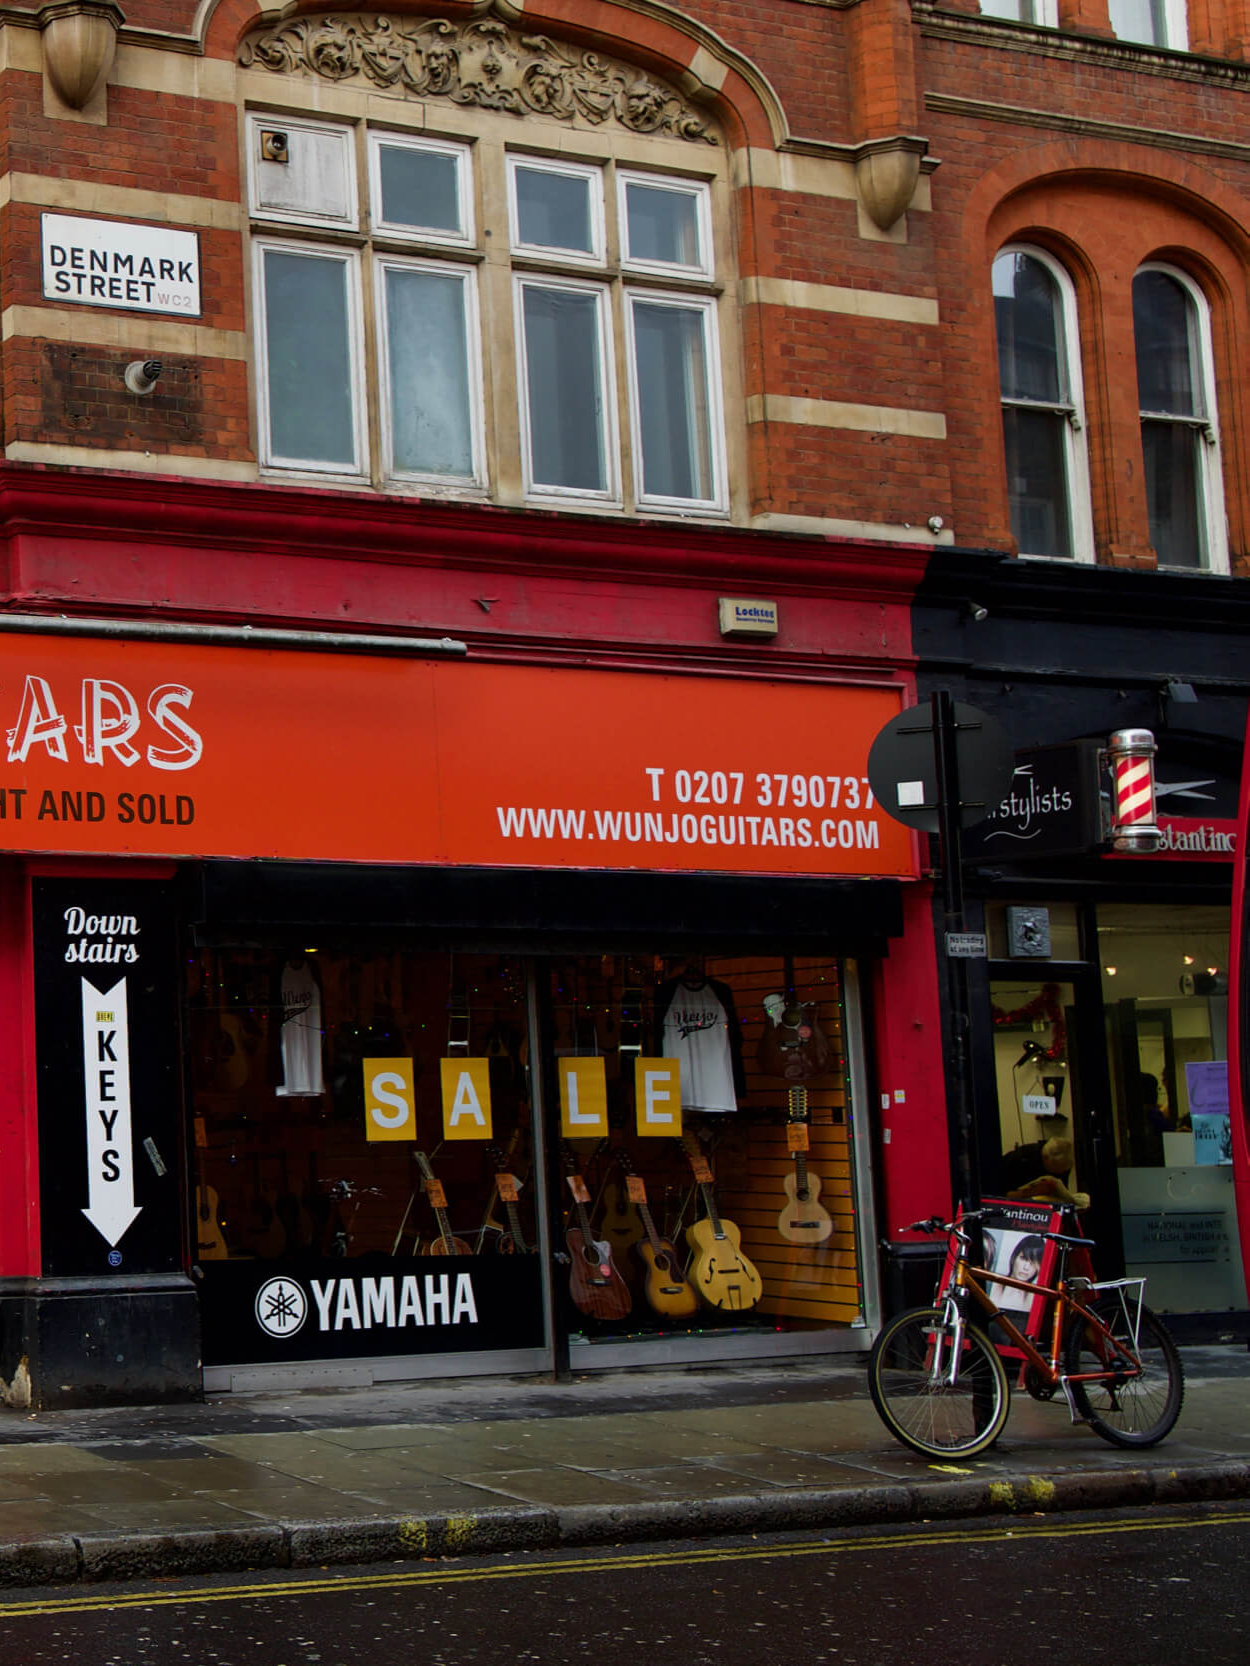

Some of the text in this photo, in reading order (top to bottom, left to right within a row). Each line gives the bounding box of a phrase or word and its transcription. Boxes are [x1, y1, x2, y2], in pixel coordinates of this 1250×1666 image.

[49, 244, 194, 284] DENMARK
[54, 270, 192, 309] STREET WC2
[37, 789, 106, 823] AND
[117, 792, 196, 826] SOLD
[645, 766, 876, 810] T 0207 3790737
[496, 806, 881, 850] WWW.WUNJOGUITARS.COM
[63, 906, 141, 936] Down
[64, 936, 140, 963] stairs
[97, 1030, 122, 1183] KEYS
[370, 1070, 673, 1129] SALE
[1029, 1100, 1050, 1111] OPEN
[310, 1273, 479, 1332] YAMAHA
